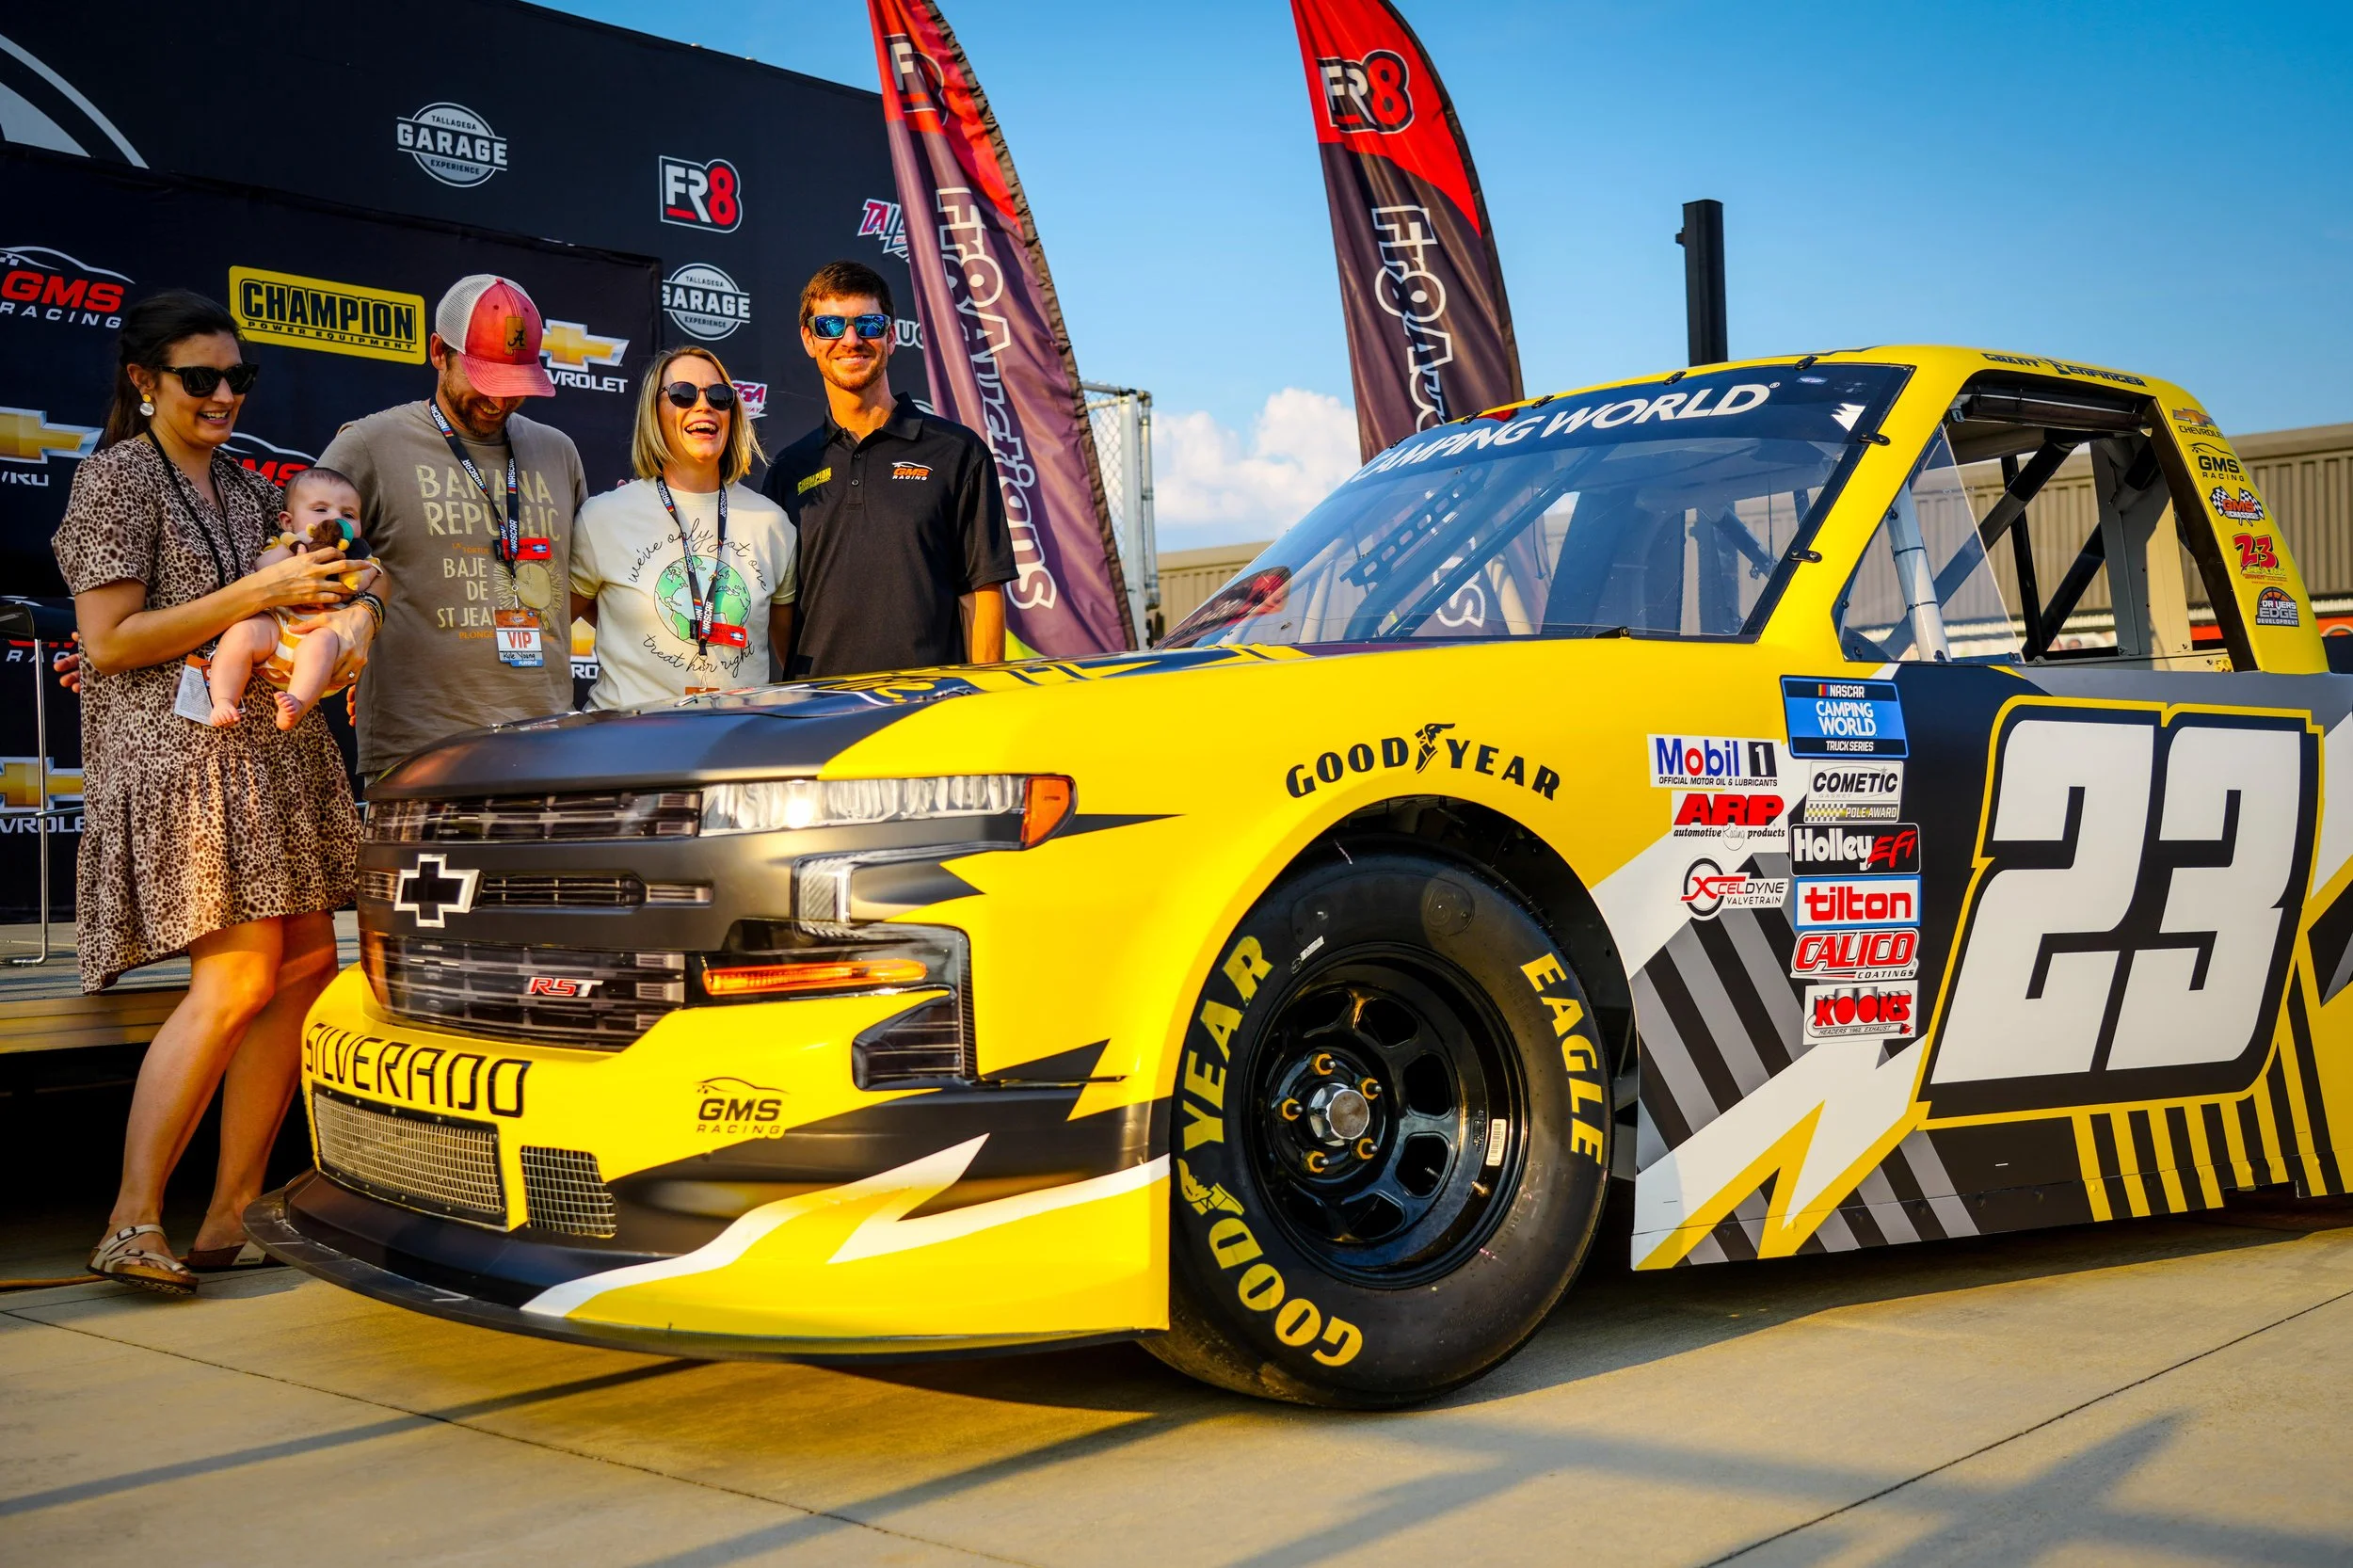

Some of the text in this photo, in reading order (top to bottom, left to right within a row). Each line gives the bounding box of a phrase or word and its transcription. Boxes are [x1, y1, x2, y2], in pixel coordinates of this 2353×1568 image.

[1321, 58, 1403, 127] FR8
[430, 114, 477, 131] TALLADEGA
[396, 122, 508, 166] GARAGE
[430, 159, 481, 175] EXPERIENCE
[664, 164, 737, 226] FR8
[1, 269, 124, 313] GMS
[0, 301, 122, 329] RACING
[242, 281, 414, 341] CHAMPION
[684, 315, 728, 329] EXPERIENCE
[248, 321, 412, 350] POWER EQUIPMENT
[507, 329, 525, 347] A
[544, 368, 629, 393] VROLET
[2178, 425, 2224, 440] CHEVROLE
[1350, 415, 1546, 484] CAMPING
[893, 468, 930, 477] GMS
[2198, 455, 2240, 473] GMS
[415, 465, 556, 505] BANANA
[2202, 472, 2245, 482] RACING
[2222, 499, 2256, 513] GMS
[2233, 533, 2279, 569] 23
[442, 557, 488, 579] BAJE
[466, 580, 489, 601] DE
[437, 607, 456, 629] ST
[701, 601, 714, 632] NASCAR
[2256, 617, 2298, 626] DEVELOPMENT
[2259, 607, 2298, 619] EDGE
[506, 632, 533, 649] VIP
[643, 633, 685, 668] treat
[720, 640, 755, 679] right
[1830, 684, 1865, 698] NASCAR
[1816, 700, 1874, 718] CAMPING
[1817, 716, 1877, 737] WORLD
[1656, 737, 1740, 776] Mobil
[1658, 776, 1689, 785] OFFICIAL
[1689, 777, 1714, 786] MOTOR
[1735, 778, 1778, 787] LUBRICANTS
[1813, 772, 1898, 793] COMETIC
[1673, 793, 1785, 825] ARP
[1845, 807, 1897, 818] POLE AWARD
[1673, 827, 1721, 838] automotive
[1747, 827, 1785, 840] products
[1793, 828, 1874, 871] Holley
[1726, 895, 1782, 905] VALVETRAIN
[1804, 886, 1912, 921] tilton
[1929, 719, 2302, 1085] 23
[1793, 931, 1918, 971] CALICO
[1857, 968, 1914, 980] COATINGS
[527, 977, 603, 998] RST
[1815, 990, 1913, 1027] KOOKS
[1817, 1028, 1848, 1036] HEADERS
[1520, 952, 1604, 1165] EAGLE
[304, 1023, 533, 1118] SILVERADO
[697, 1097, 783, 1122] GMS
[695, 1123, 783, 1135] RACING
